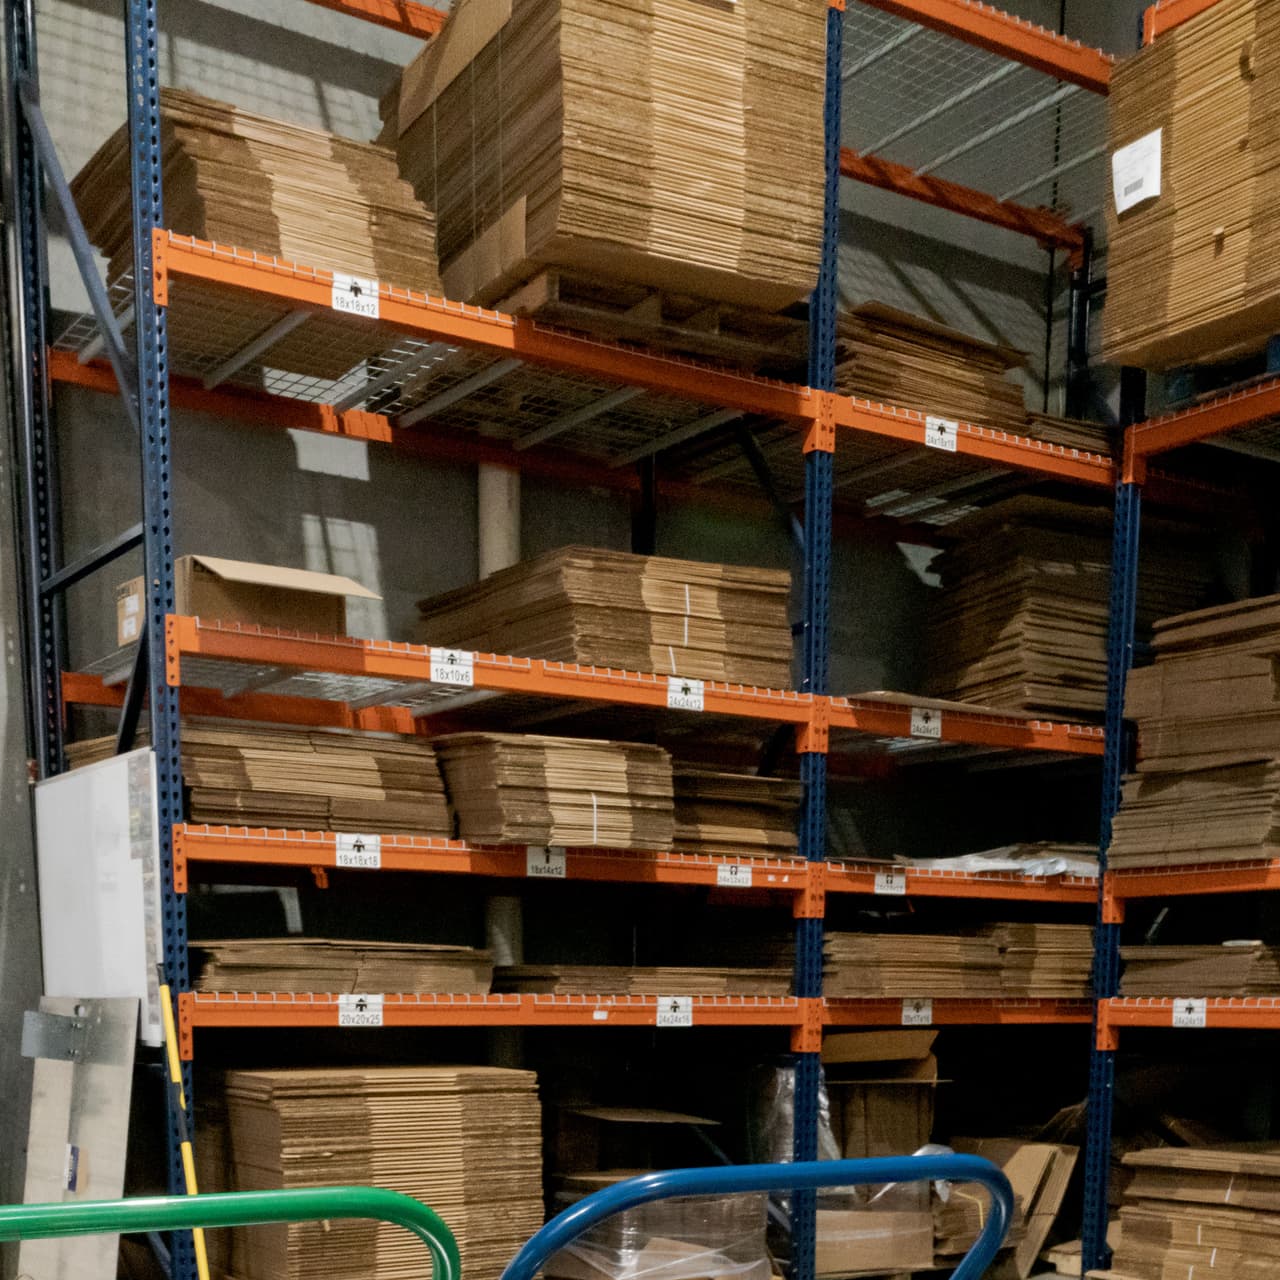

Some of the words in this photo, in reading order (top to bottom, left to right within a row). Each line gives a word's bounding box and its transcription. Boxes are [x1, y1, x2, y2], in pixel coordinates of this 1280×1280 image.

[335, 296, 376, 316] 18x18x12
[435, 667, 470, 682] 18x10x6
[669, 697, 702, 709] 24x24x12
[339, 854, 378, 866] 18x18x18
